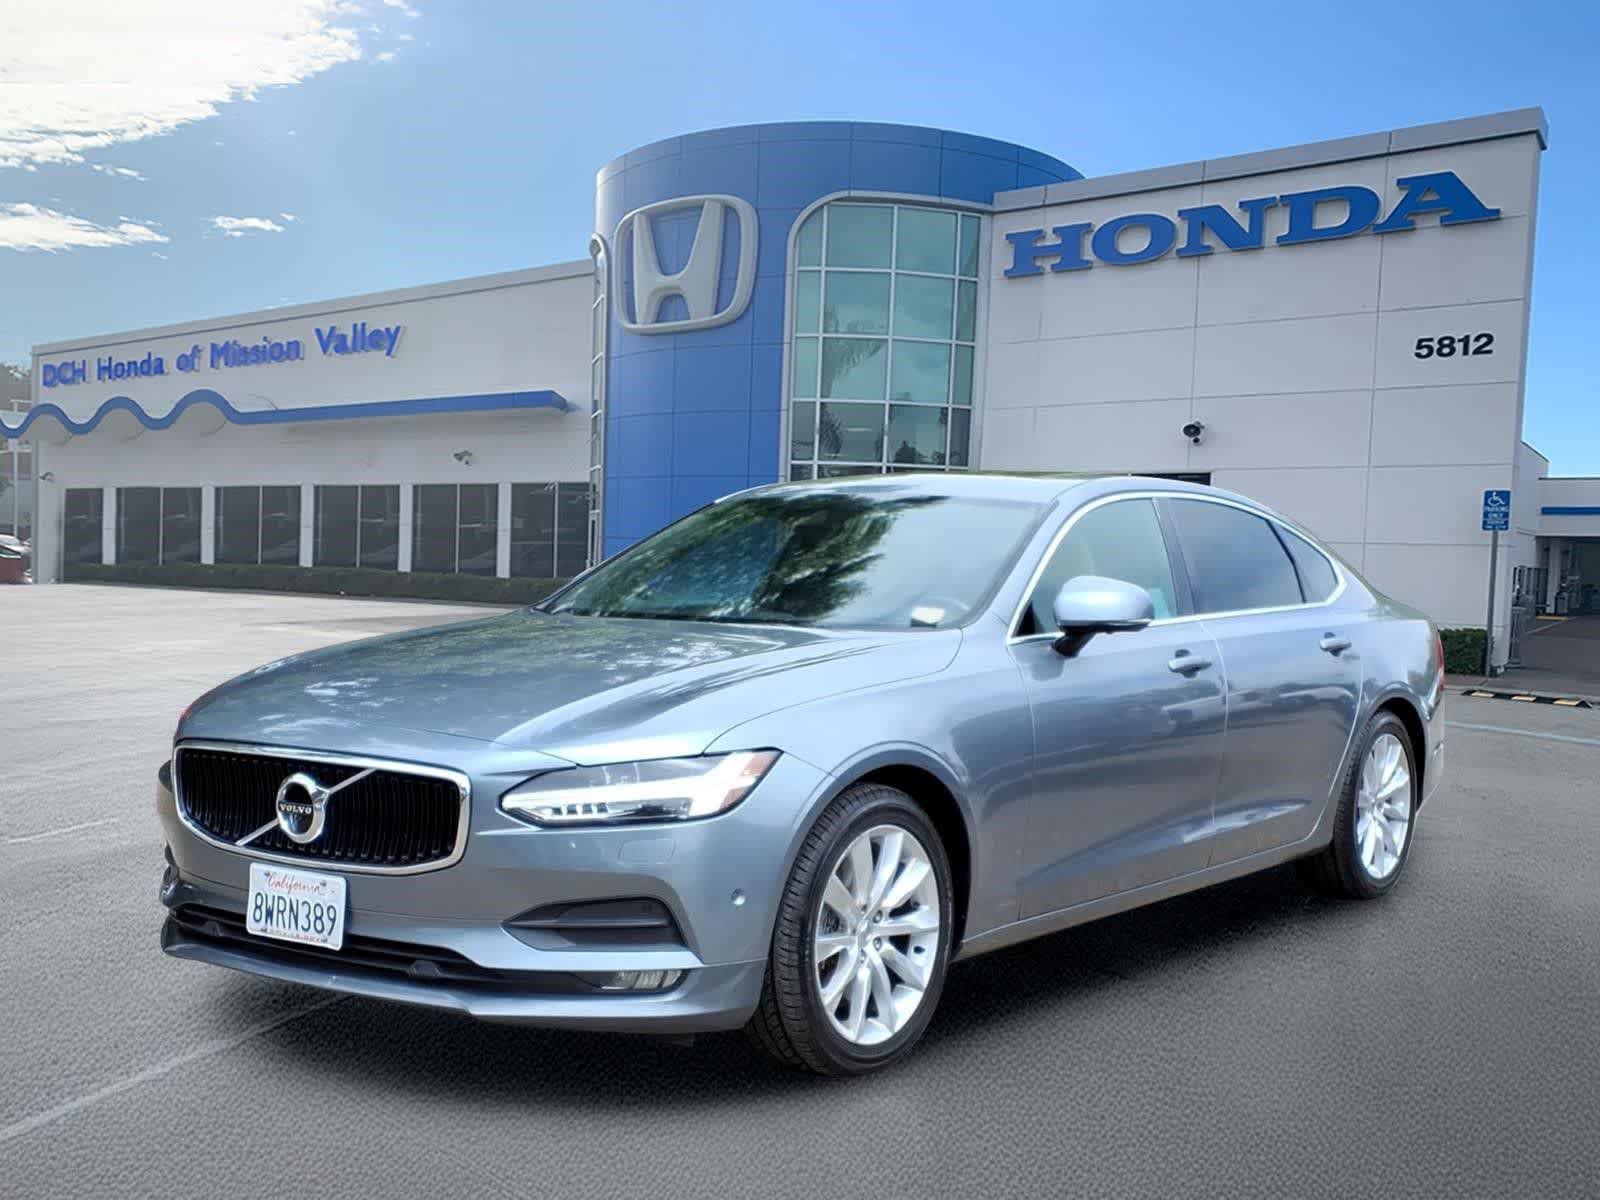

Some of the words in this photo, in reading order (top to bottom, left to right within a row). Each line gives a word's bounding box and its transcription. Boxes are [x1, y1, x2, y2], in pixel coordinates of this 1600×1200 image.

[1004, 171, 1501, 277] HONDA
[42, 361, 87, 388] DCH
[97, 352, 165, 381] Honda
[176, 345, 201, 373] of
[210, 336, 303, 369] Mission
[315, 322, 402, 357] Valley
[1414, 333, 1494, 359] 5812
[280, 803, 312, 814] VOLVO
[252, 892, 337, 936] 8WRN389
